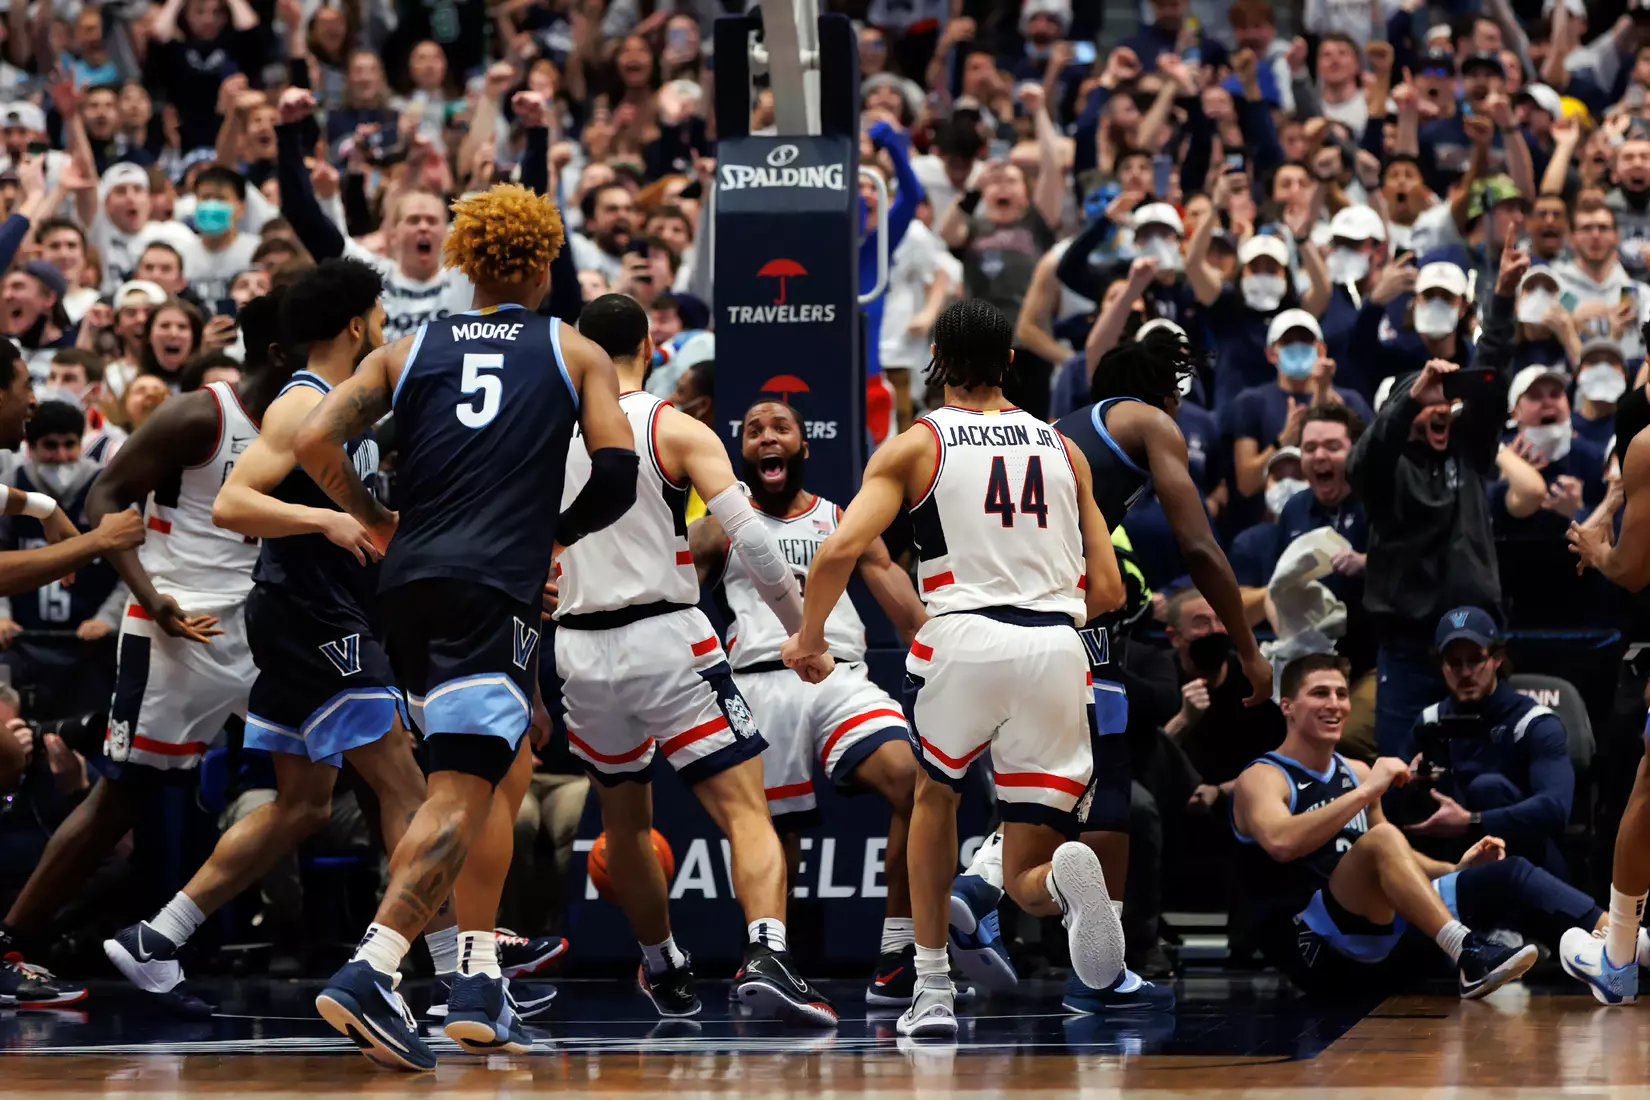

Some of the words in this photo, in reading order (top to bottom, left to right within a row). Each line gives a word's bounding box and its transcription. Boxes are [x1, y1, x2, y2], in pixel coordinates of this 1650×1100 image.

[720, 163, 844, 191] SPALDING
[727, 304, 836, 324] TRAVELERS
[451, 322, 524, 342] MOORE
[455, 353, 504, 429] 5
[947, 425, 1030, 447] JACKSON
[984, 455, 1049, 529] 44
